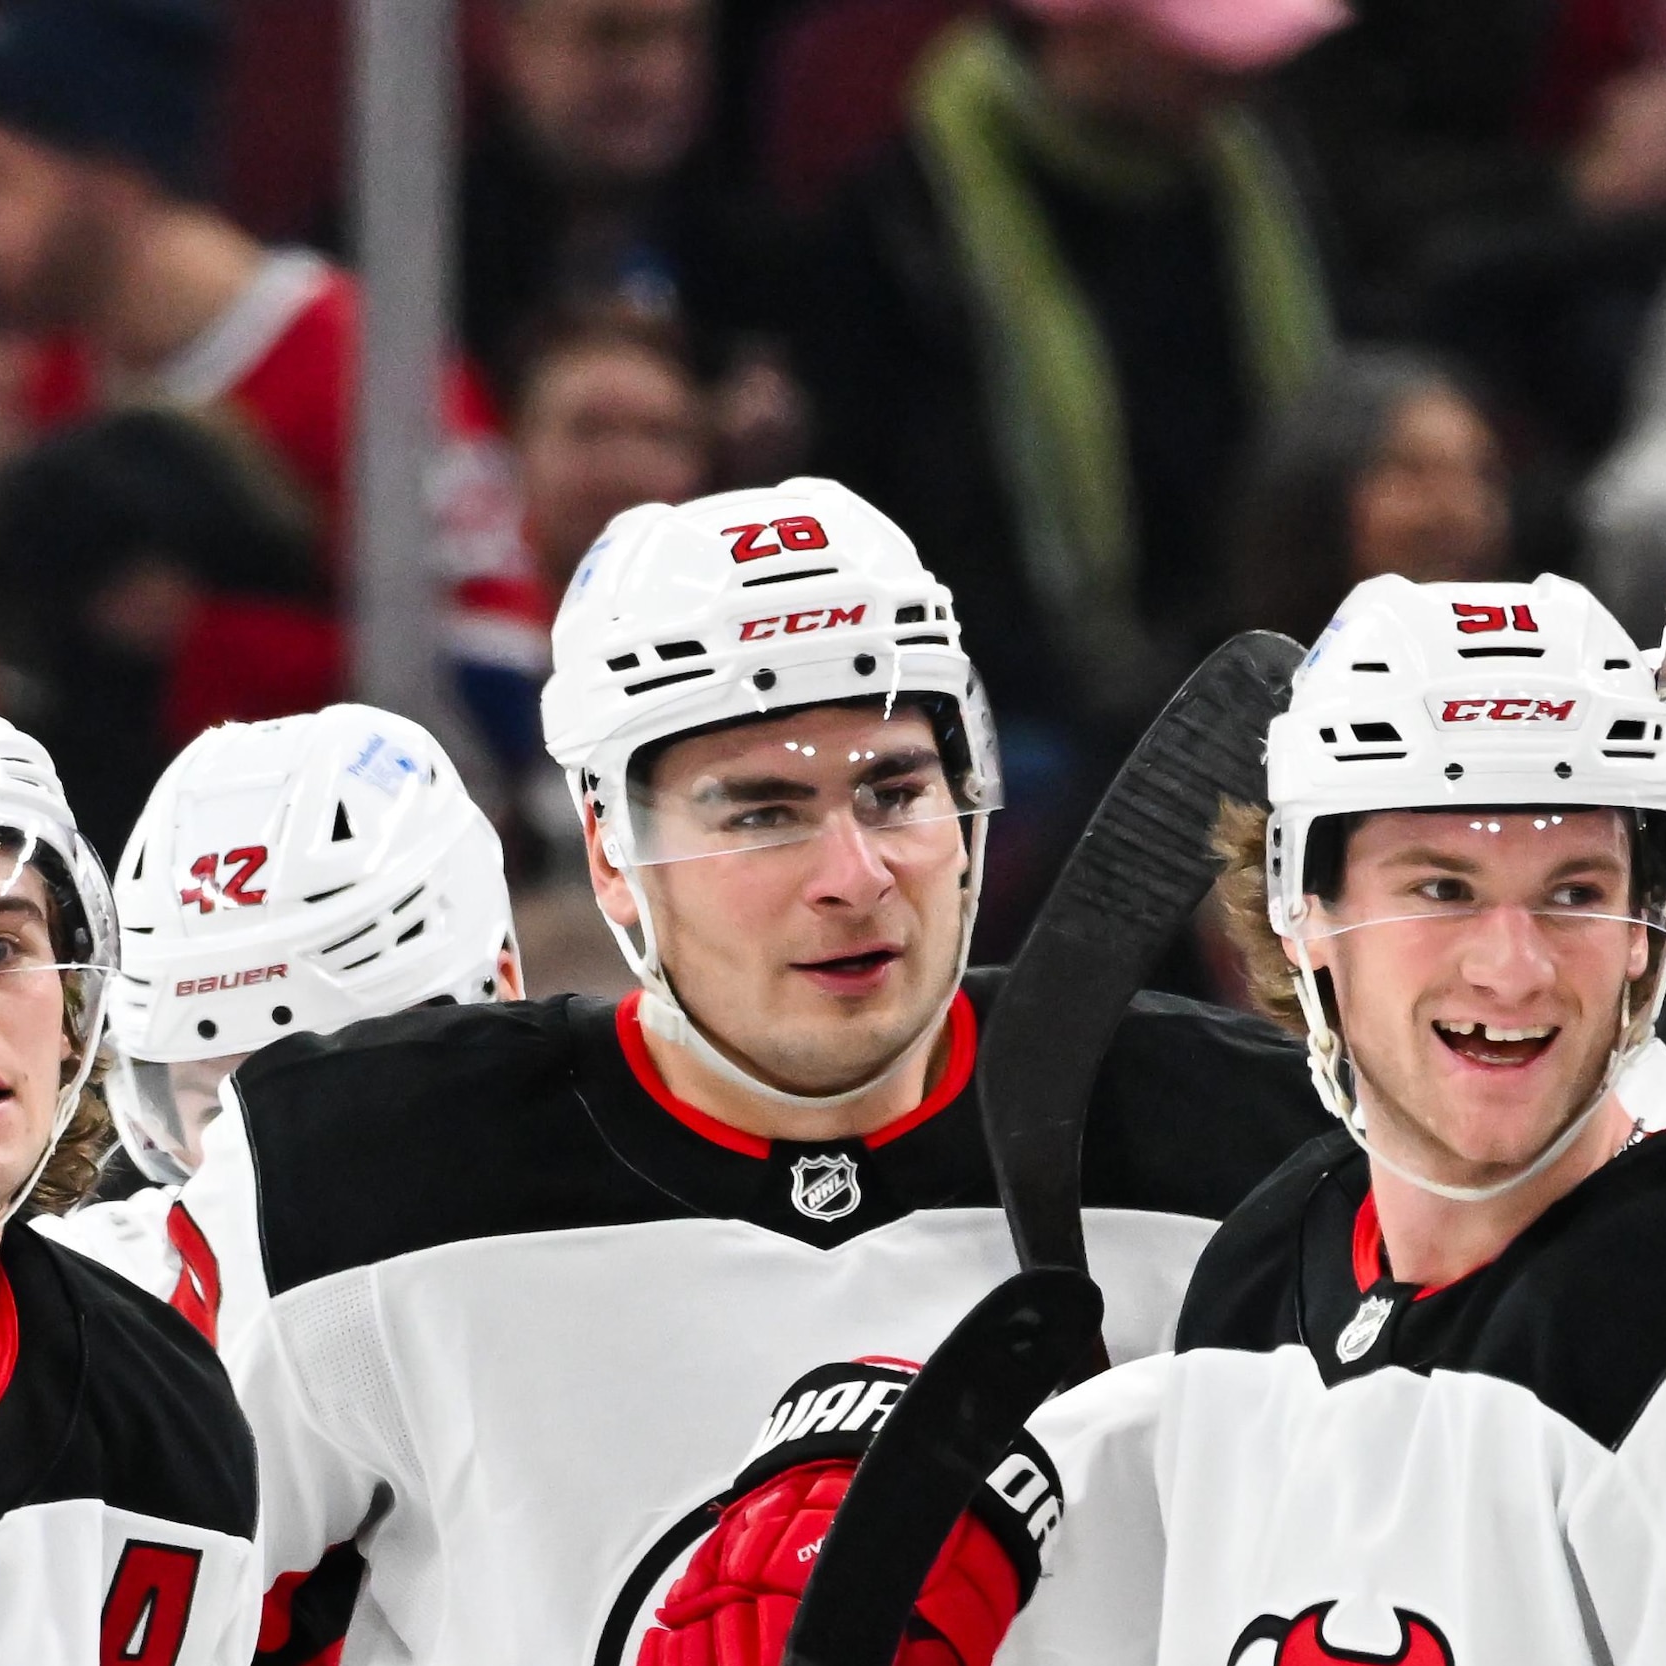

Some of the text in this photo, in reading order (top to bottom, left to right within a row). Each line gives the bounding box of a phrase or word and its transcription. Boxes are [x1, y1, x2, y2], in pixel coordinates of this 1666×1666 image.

[721, 515, 830, 564] 28
[739, 604, 866, 642] CCM
[1442, 699, 1577, 723] CCM
[180, 845, 269, 915] 42
[175, 963, 289, 997] BAUER
